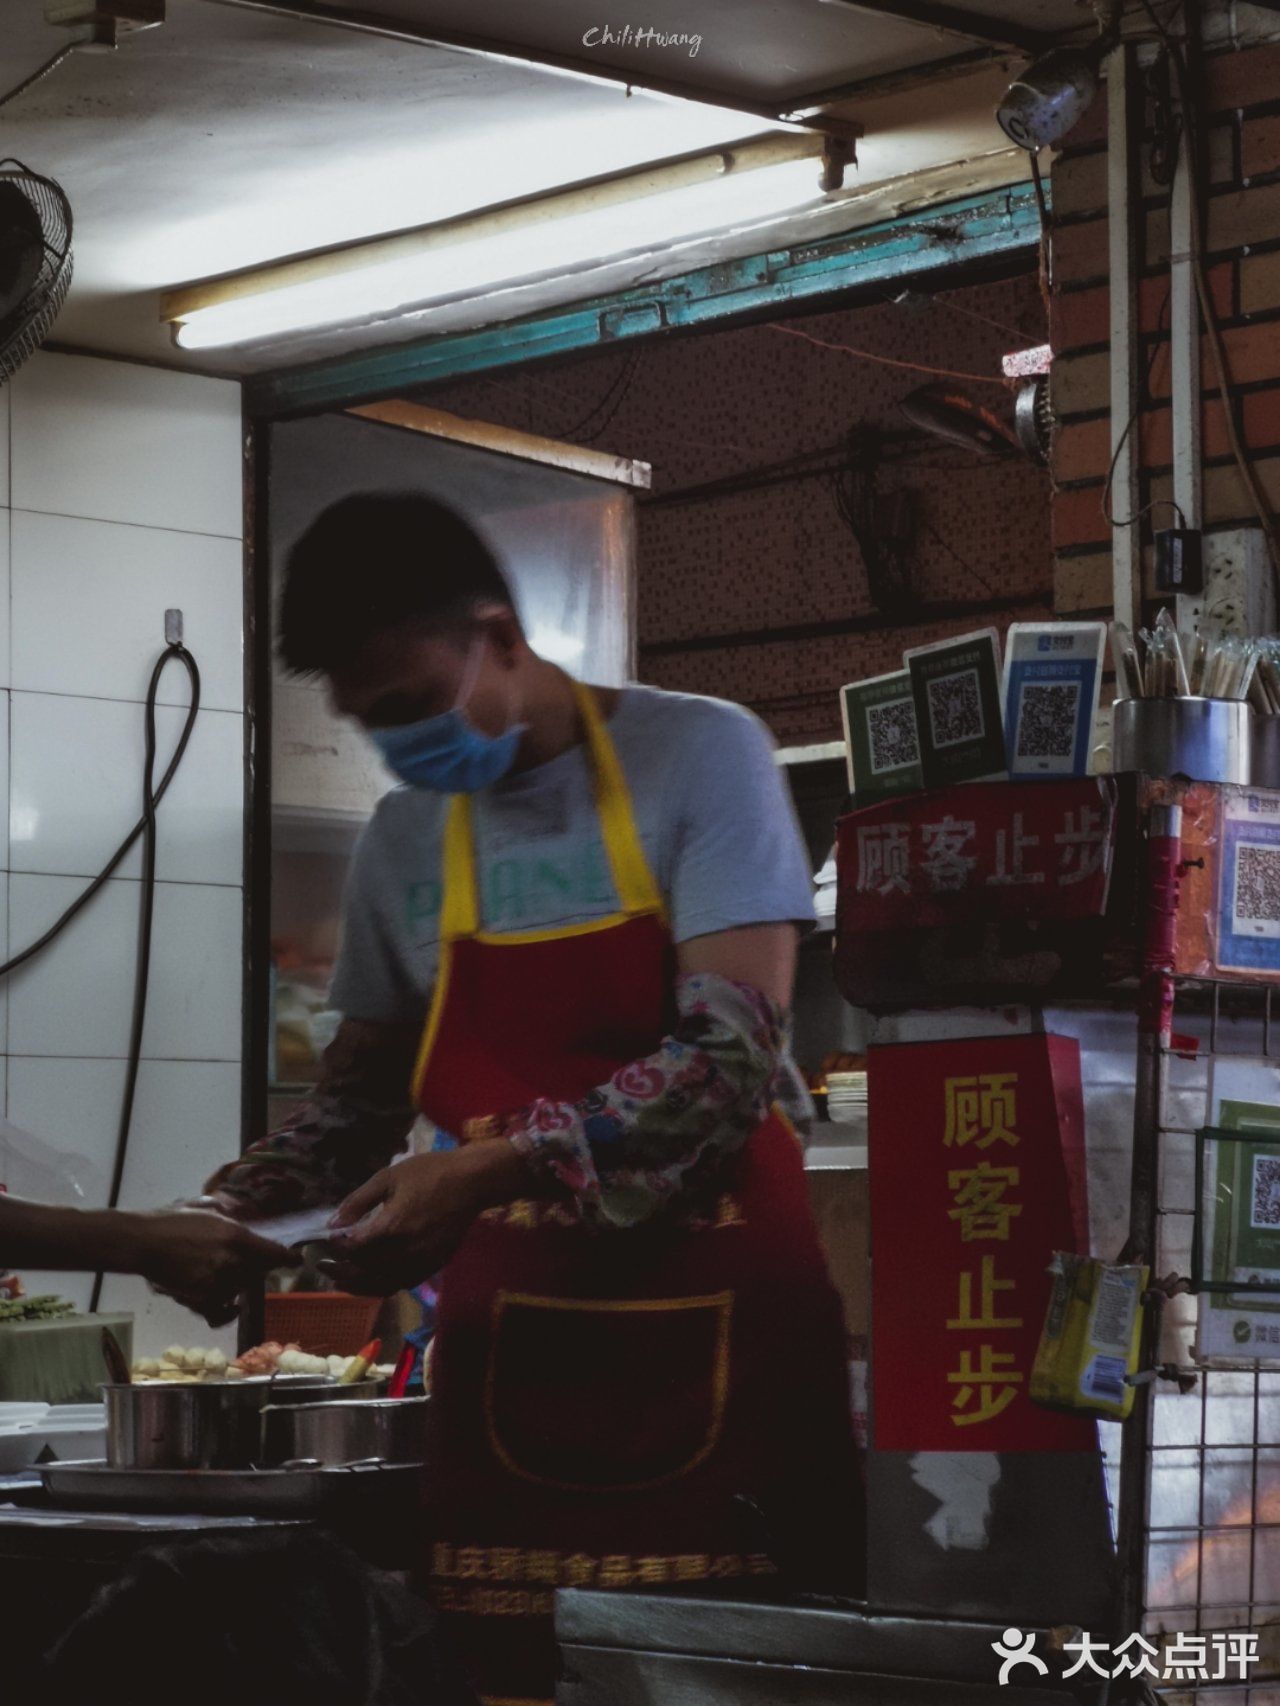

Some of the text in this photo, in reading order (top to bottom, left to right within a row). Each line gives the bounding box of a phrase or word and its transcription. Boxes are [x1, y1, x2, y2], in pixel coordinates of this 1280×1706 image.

[856, 804, 1103, 896] 顾客止步
[941, 1071, 1024, 1429] 顾客止步
